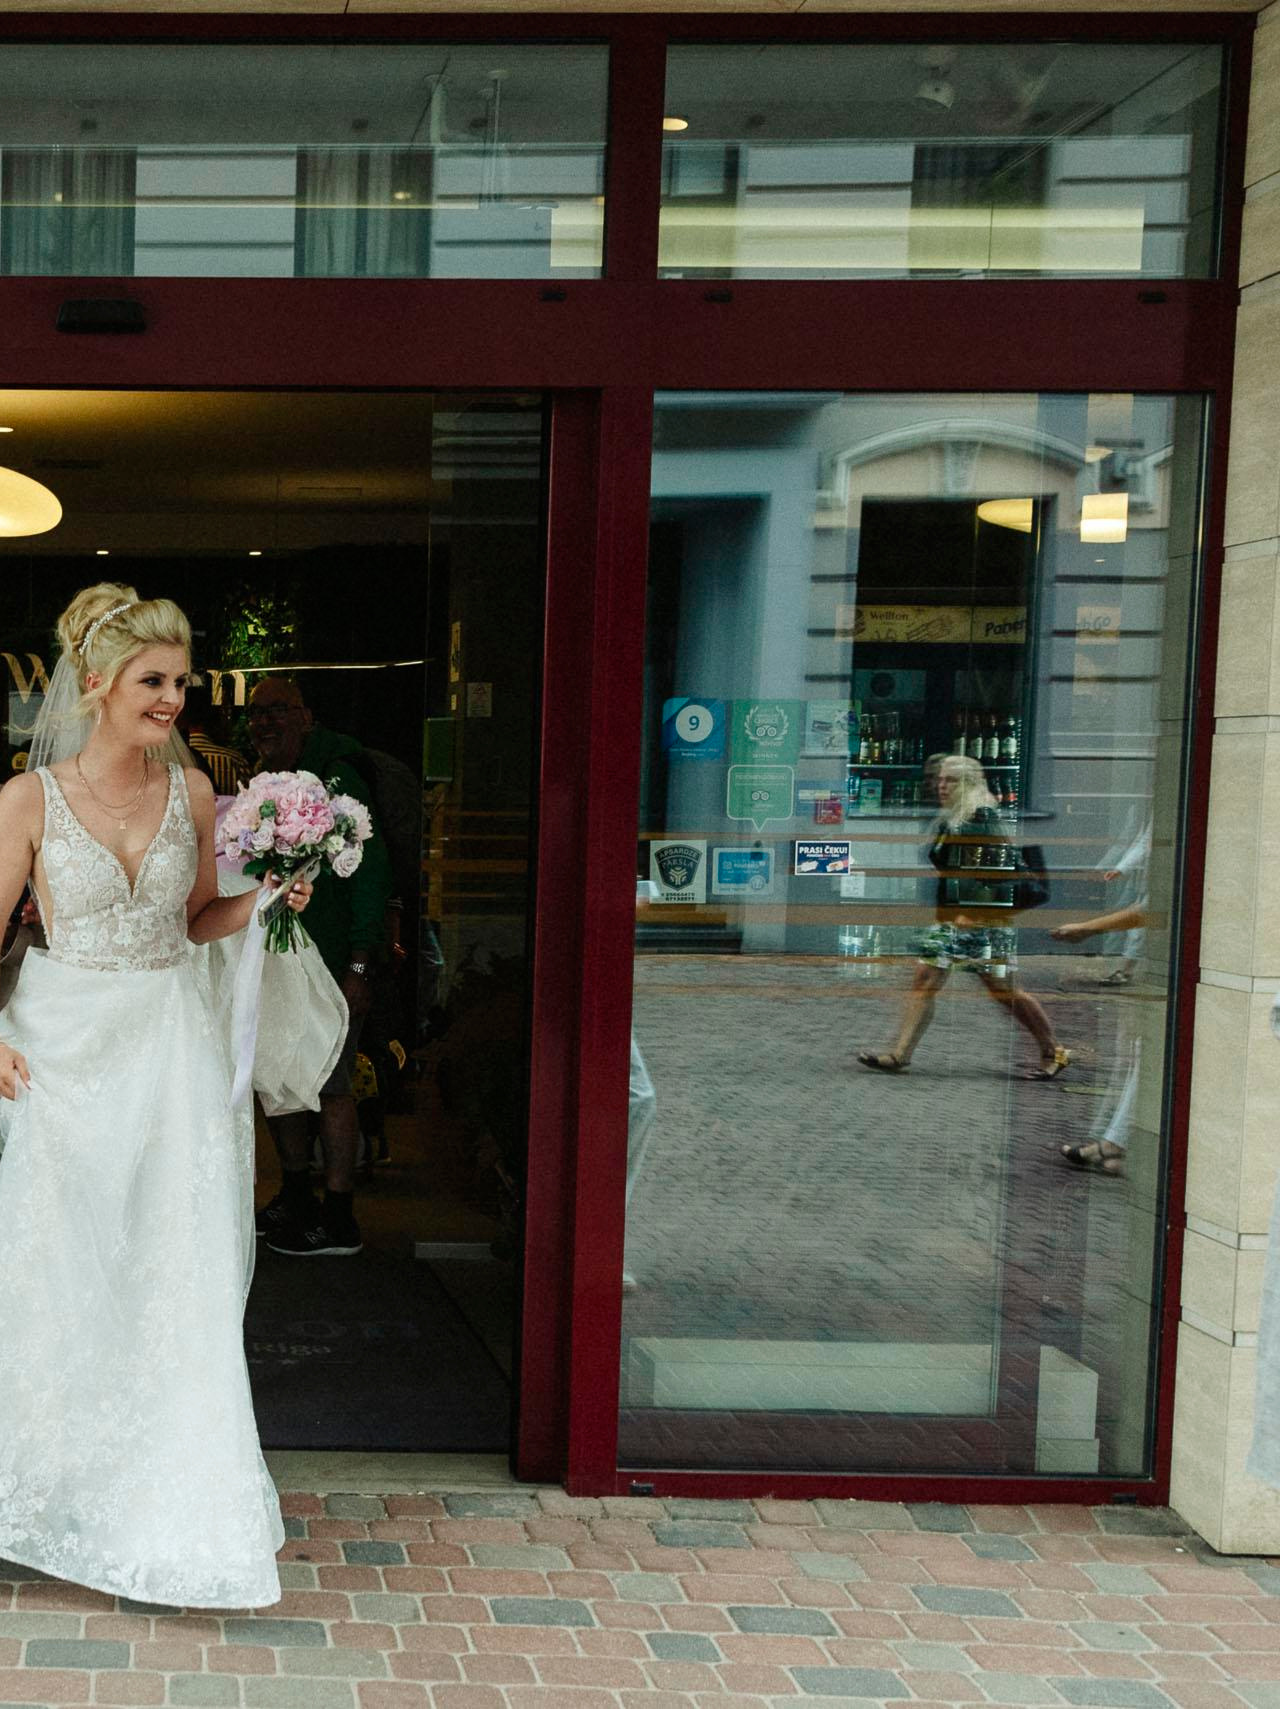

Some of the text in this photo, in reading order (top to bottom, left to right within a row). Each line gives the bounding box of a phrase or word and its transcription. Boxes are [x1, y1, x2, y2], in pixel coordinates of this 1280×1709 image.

[688, 715, 700, 731] 9
[799, 845, 848, 854] PRASI ČEKU!
